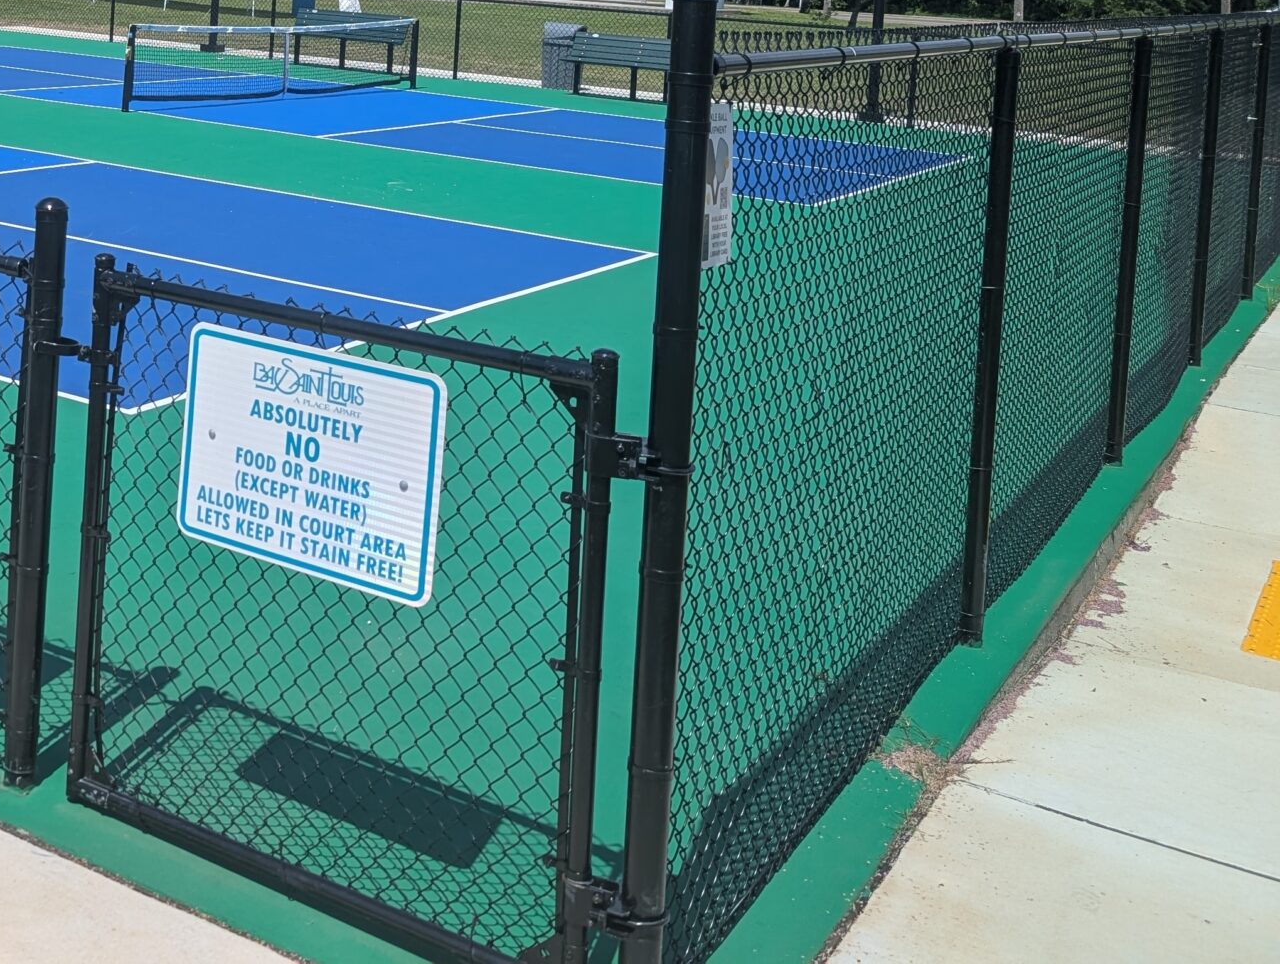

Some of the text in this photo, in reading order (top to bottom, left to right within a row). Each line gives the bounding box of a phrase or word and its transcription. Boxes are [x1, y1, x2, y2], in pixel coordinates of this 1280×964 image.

[253, 358, 364, 408] BAY SAINT LOUIS
[250, 399, 364, 443] ABSOLUTELY
[302, 399, 330, 412] PLACE
[333, 406, 362, 420] APART
[236, 446, 370, 498] FOOD OR DRINKS
[285, 431, 320, 462] NO
[196, 485, 406, 561] ALLOWED IN COURT AREA
[235, 470, 366, 526] (EXCEPT WATER)
[196, 505, 403, 583] LETS KEEP IT STAIN FREE!
